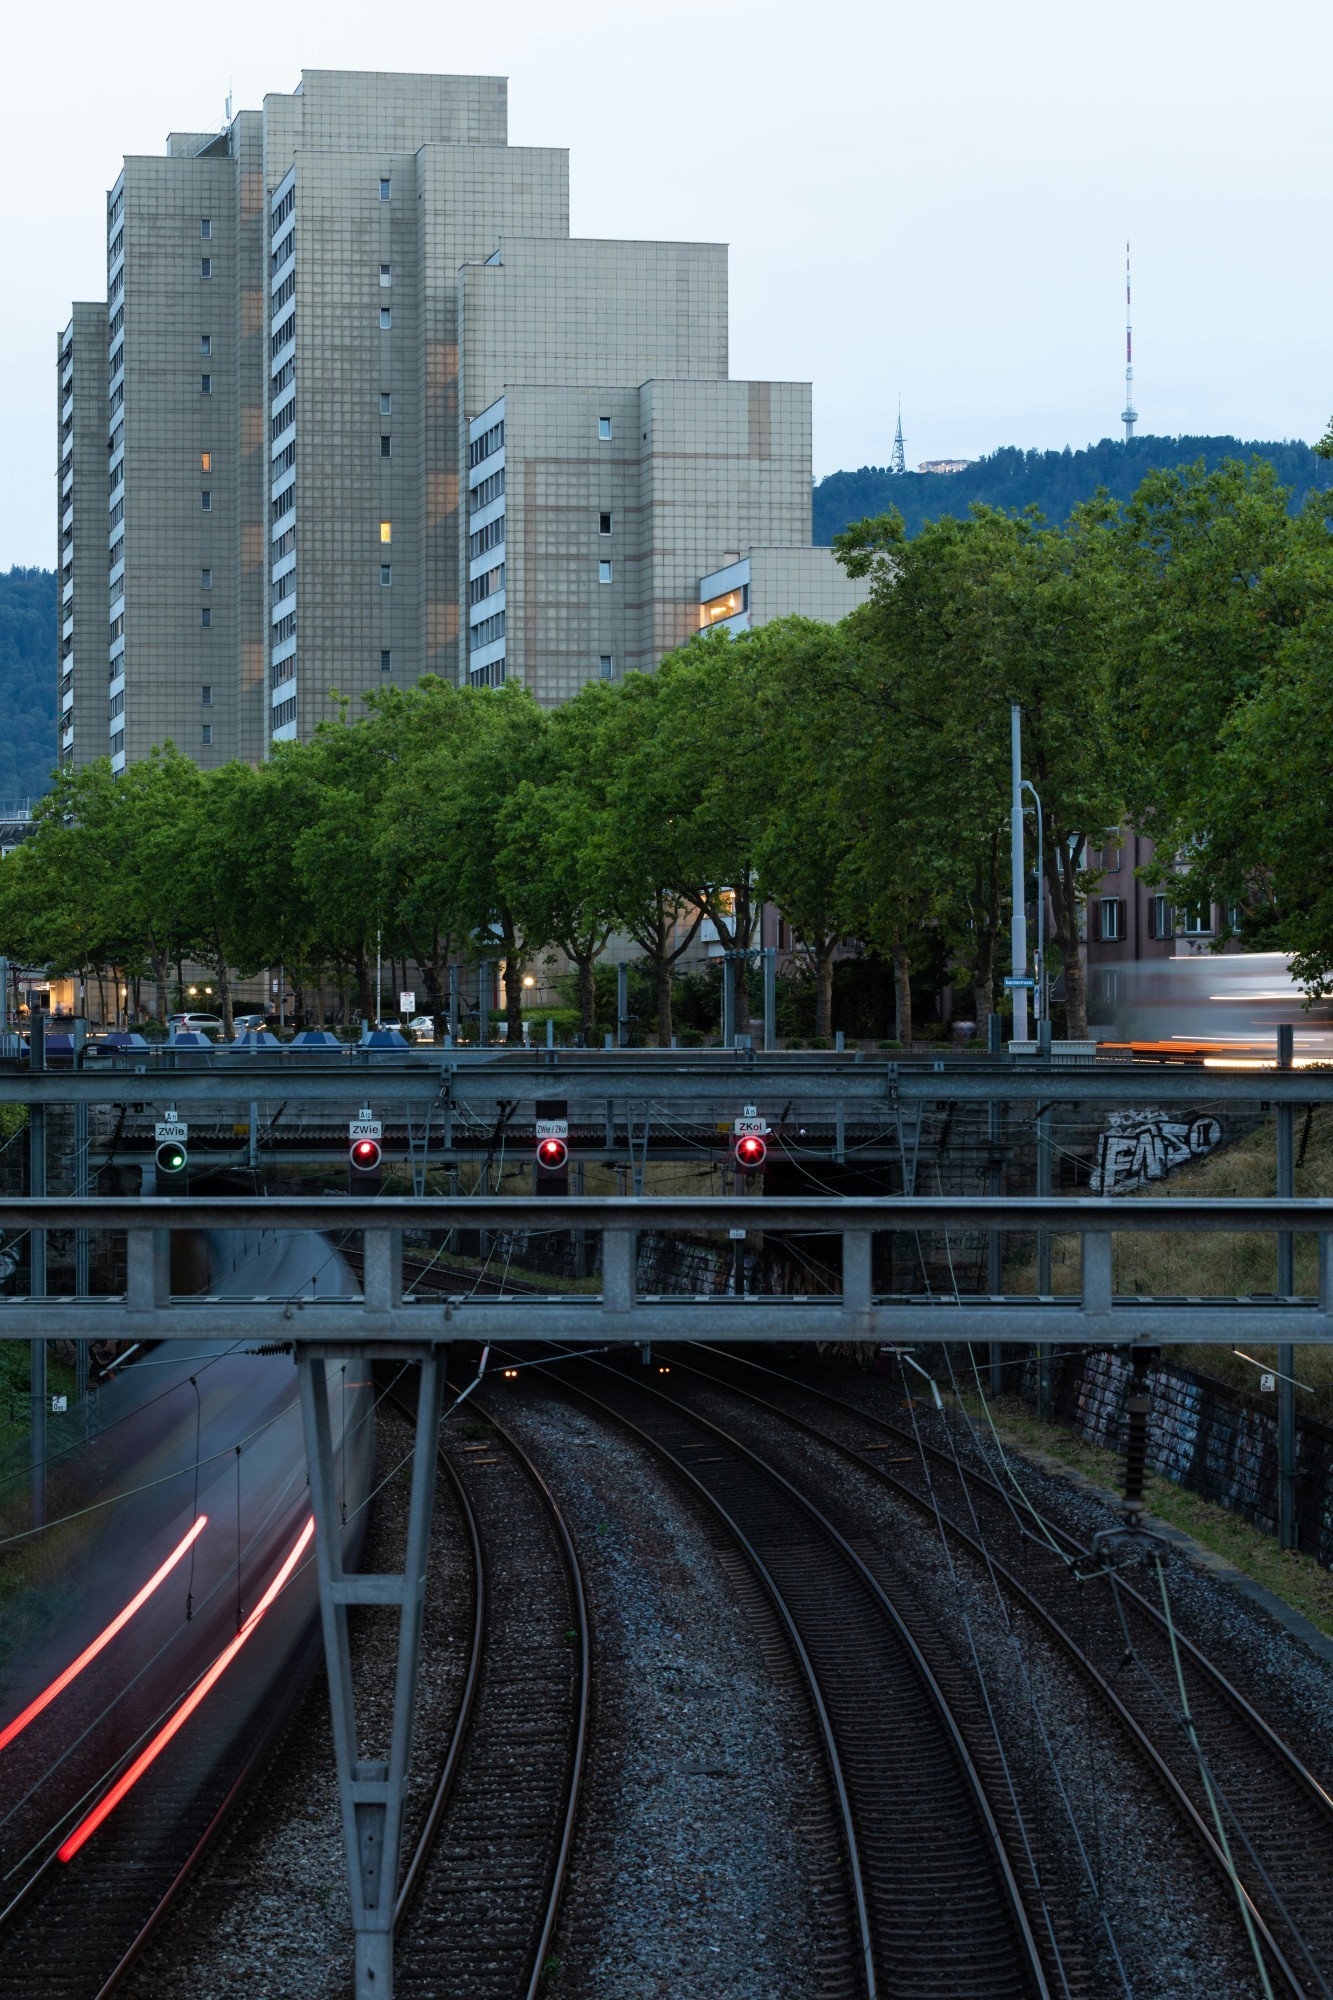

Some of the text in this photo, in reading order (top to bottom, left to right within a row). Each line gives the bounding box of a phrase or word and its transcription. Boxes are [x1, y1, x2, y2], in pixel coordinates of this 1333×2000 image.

[158, 1126, 185, 1136] ZWie
[352, 1124, 379, 1134] ZWie
[537, 1125, 551, 1134] ZWie
[739, 1122, 762, 1131] ZKol
[1264, 1375, 1269, 1384] 2
